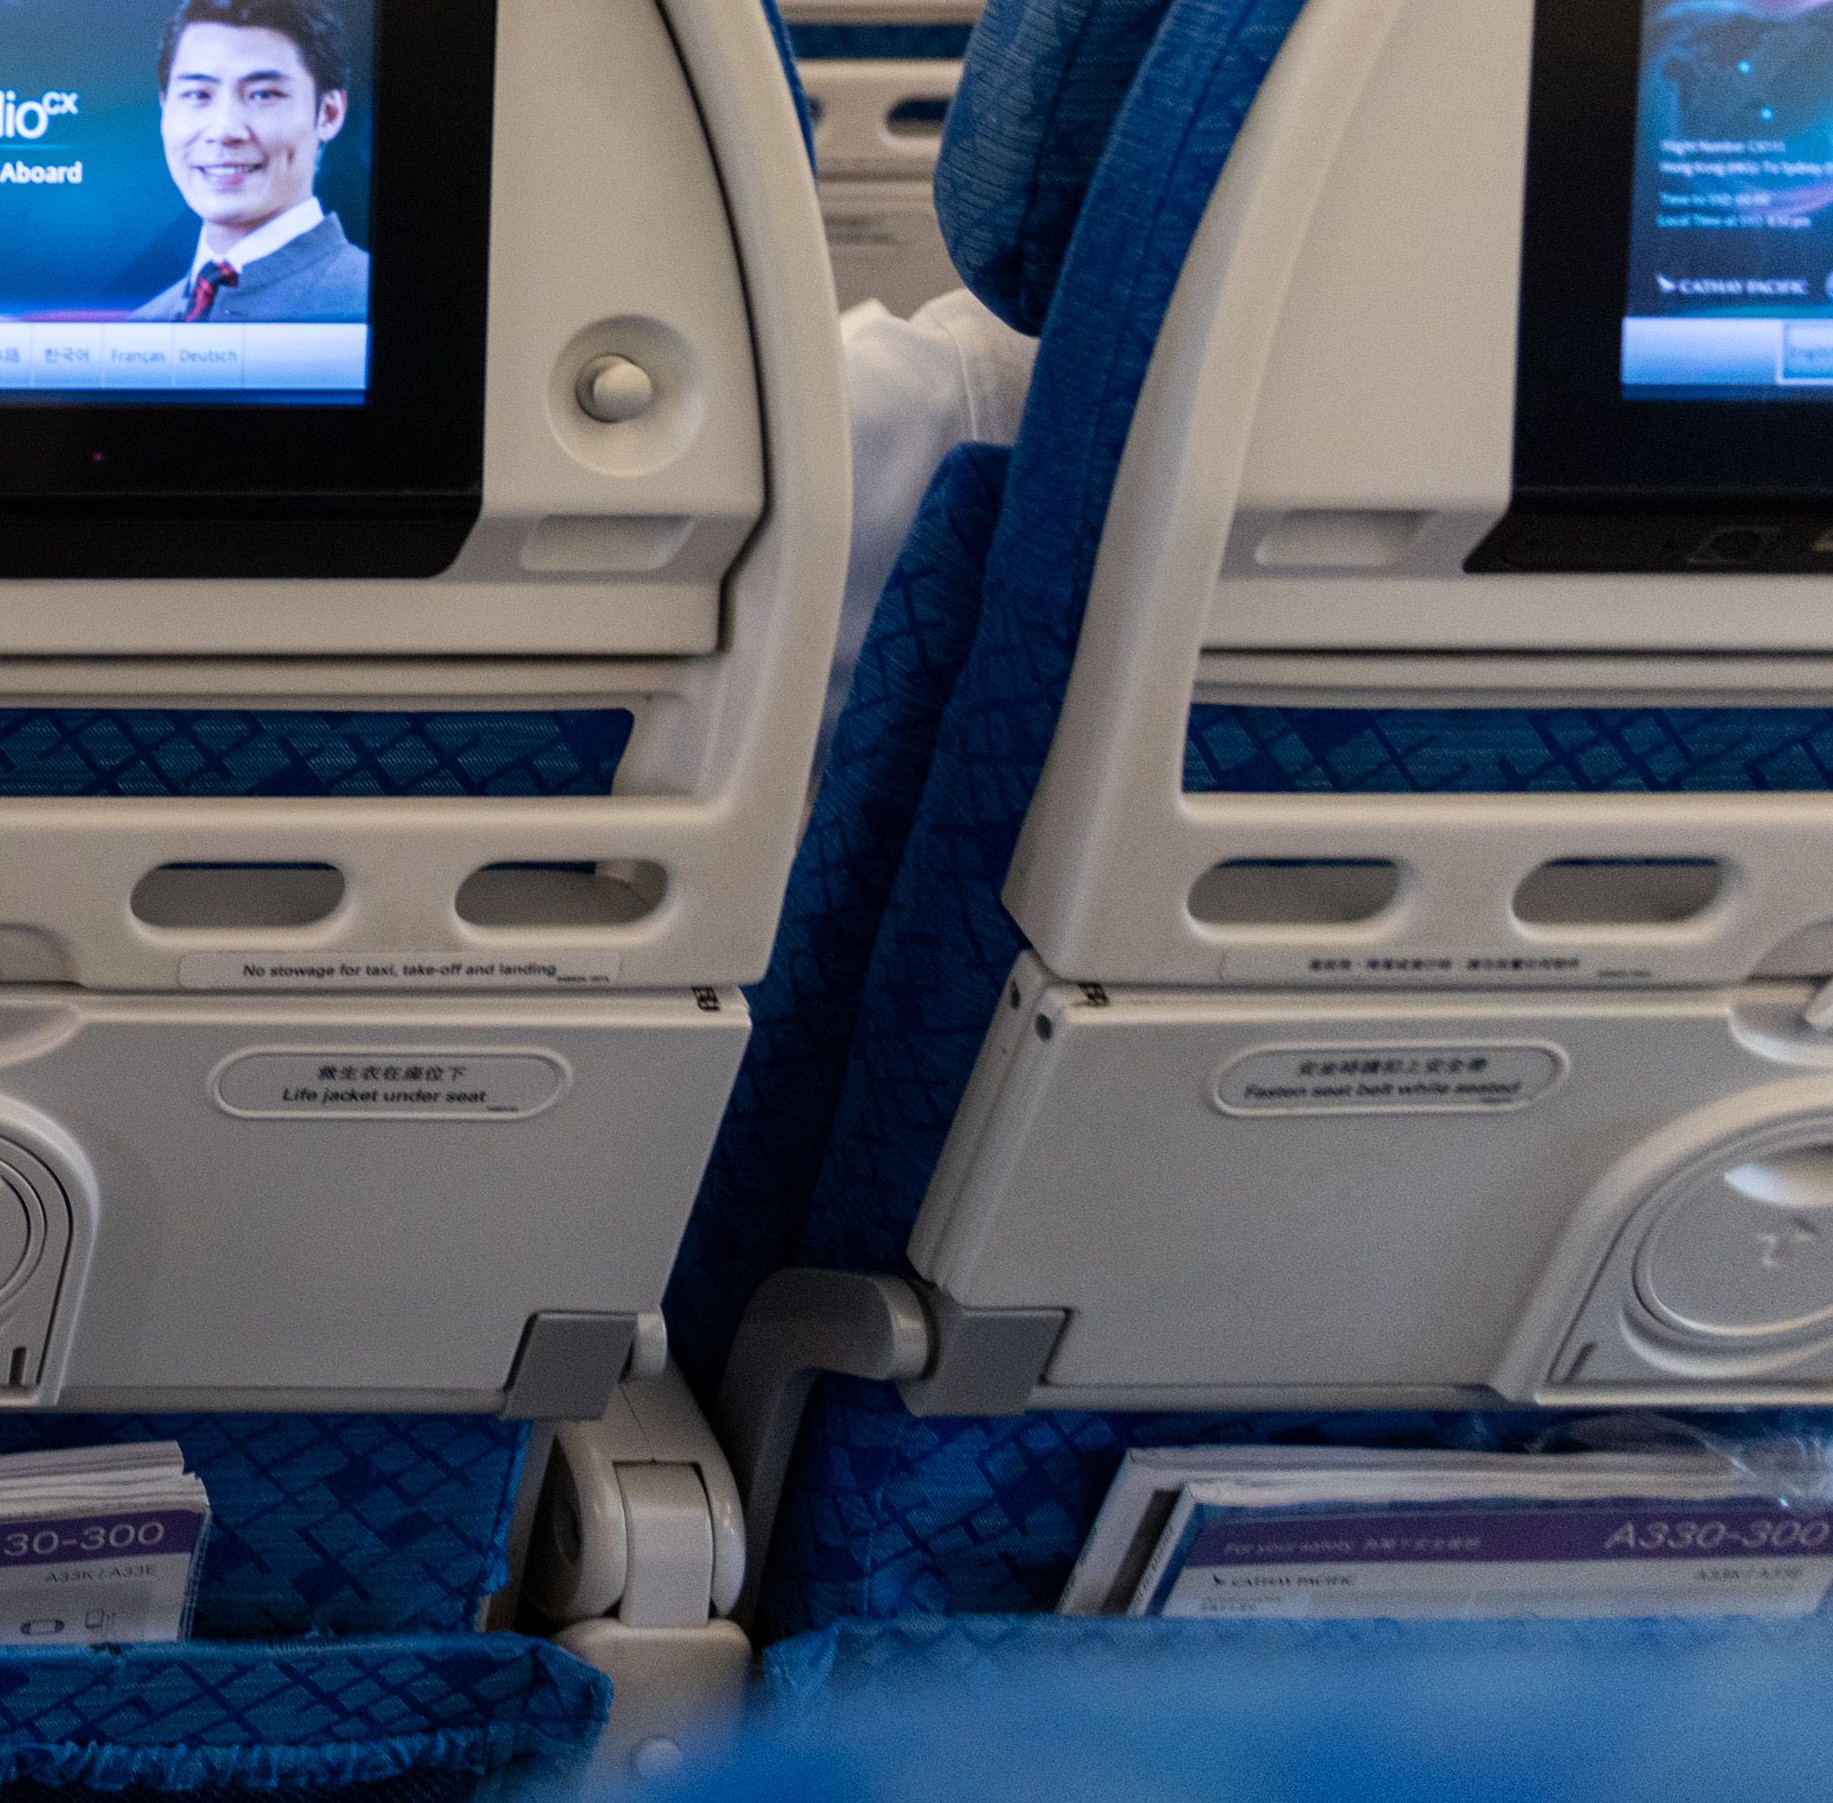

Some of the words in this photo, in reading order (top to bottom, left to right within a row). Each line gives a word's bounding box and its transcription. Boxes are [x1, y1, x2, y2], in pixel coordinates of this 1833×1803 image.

[0, 161, 83, 185] Aboard
[180, 347, 238, 363] Deutsch
[242, 964, 266, 977] No
[270, 965, 335, 979] stowage
[340, 963, 361, 976] for
[403, 963, 462, 976] take-off
[465, 963, 495, 976] and
[498, 962, 557, 978] landing
[282, 1087, 318, 1103] Life
[322, 1088, 378, 1104] jacket
[383, 1087, 442, 1103] under
[445, 1090, 487, 1103] seat
[1605, 1519, 1830, 1550] A330-300
